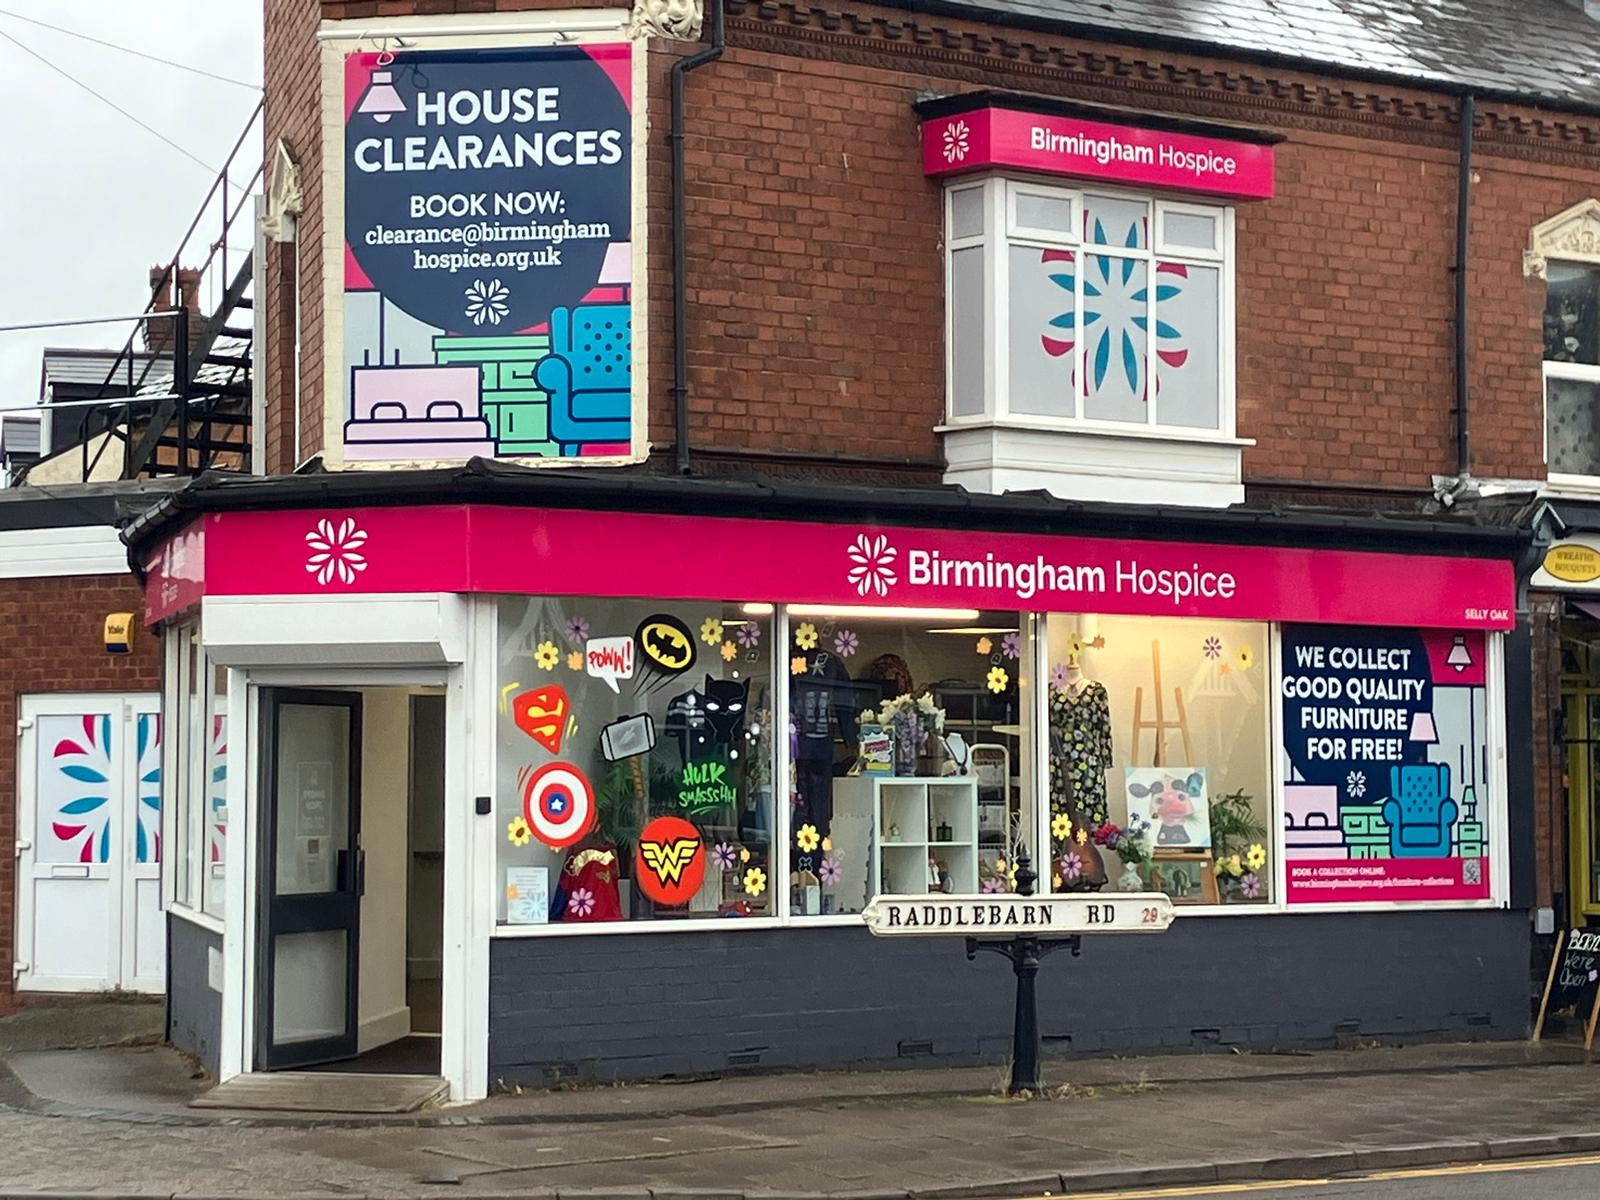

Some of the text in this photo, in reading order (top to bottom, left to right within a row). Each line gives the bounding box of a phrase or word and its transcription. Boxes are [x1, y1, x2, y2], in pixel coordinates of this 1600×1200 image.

[417, 87, 560, 126] HOUSE
[354, 130, 622, 173] CLEARANCES
[1030, 126, 1237, 176] Birmingham Hospice
[410, 190, 566, 218] BOOK NOW:
[365, 220, 611, 247] clearance@birmingham
[413, 246, 561, 272] hospice.org.uk
[908, 549, 1236, 604] Birmingham Hospice
[1465, 608, 1509, 621] SELLY OAK
[107, 625, 125, 634] Yale
[588, 641, 632, 674] POWW!
[1295, 646, 1411, 671] WE COLLECT
[1282, 676, 1425, 704] GOOD QUALITY
[1301, 707, 1408, 730] FURNITURE
[1307, 737, 1403, 761] FOR FREE!
[682, 762, 727, 787] HULK
[888, 904, 1158, 927] RADDLEBARN RD 29
[1560, 968, 1587, 992] Open
